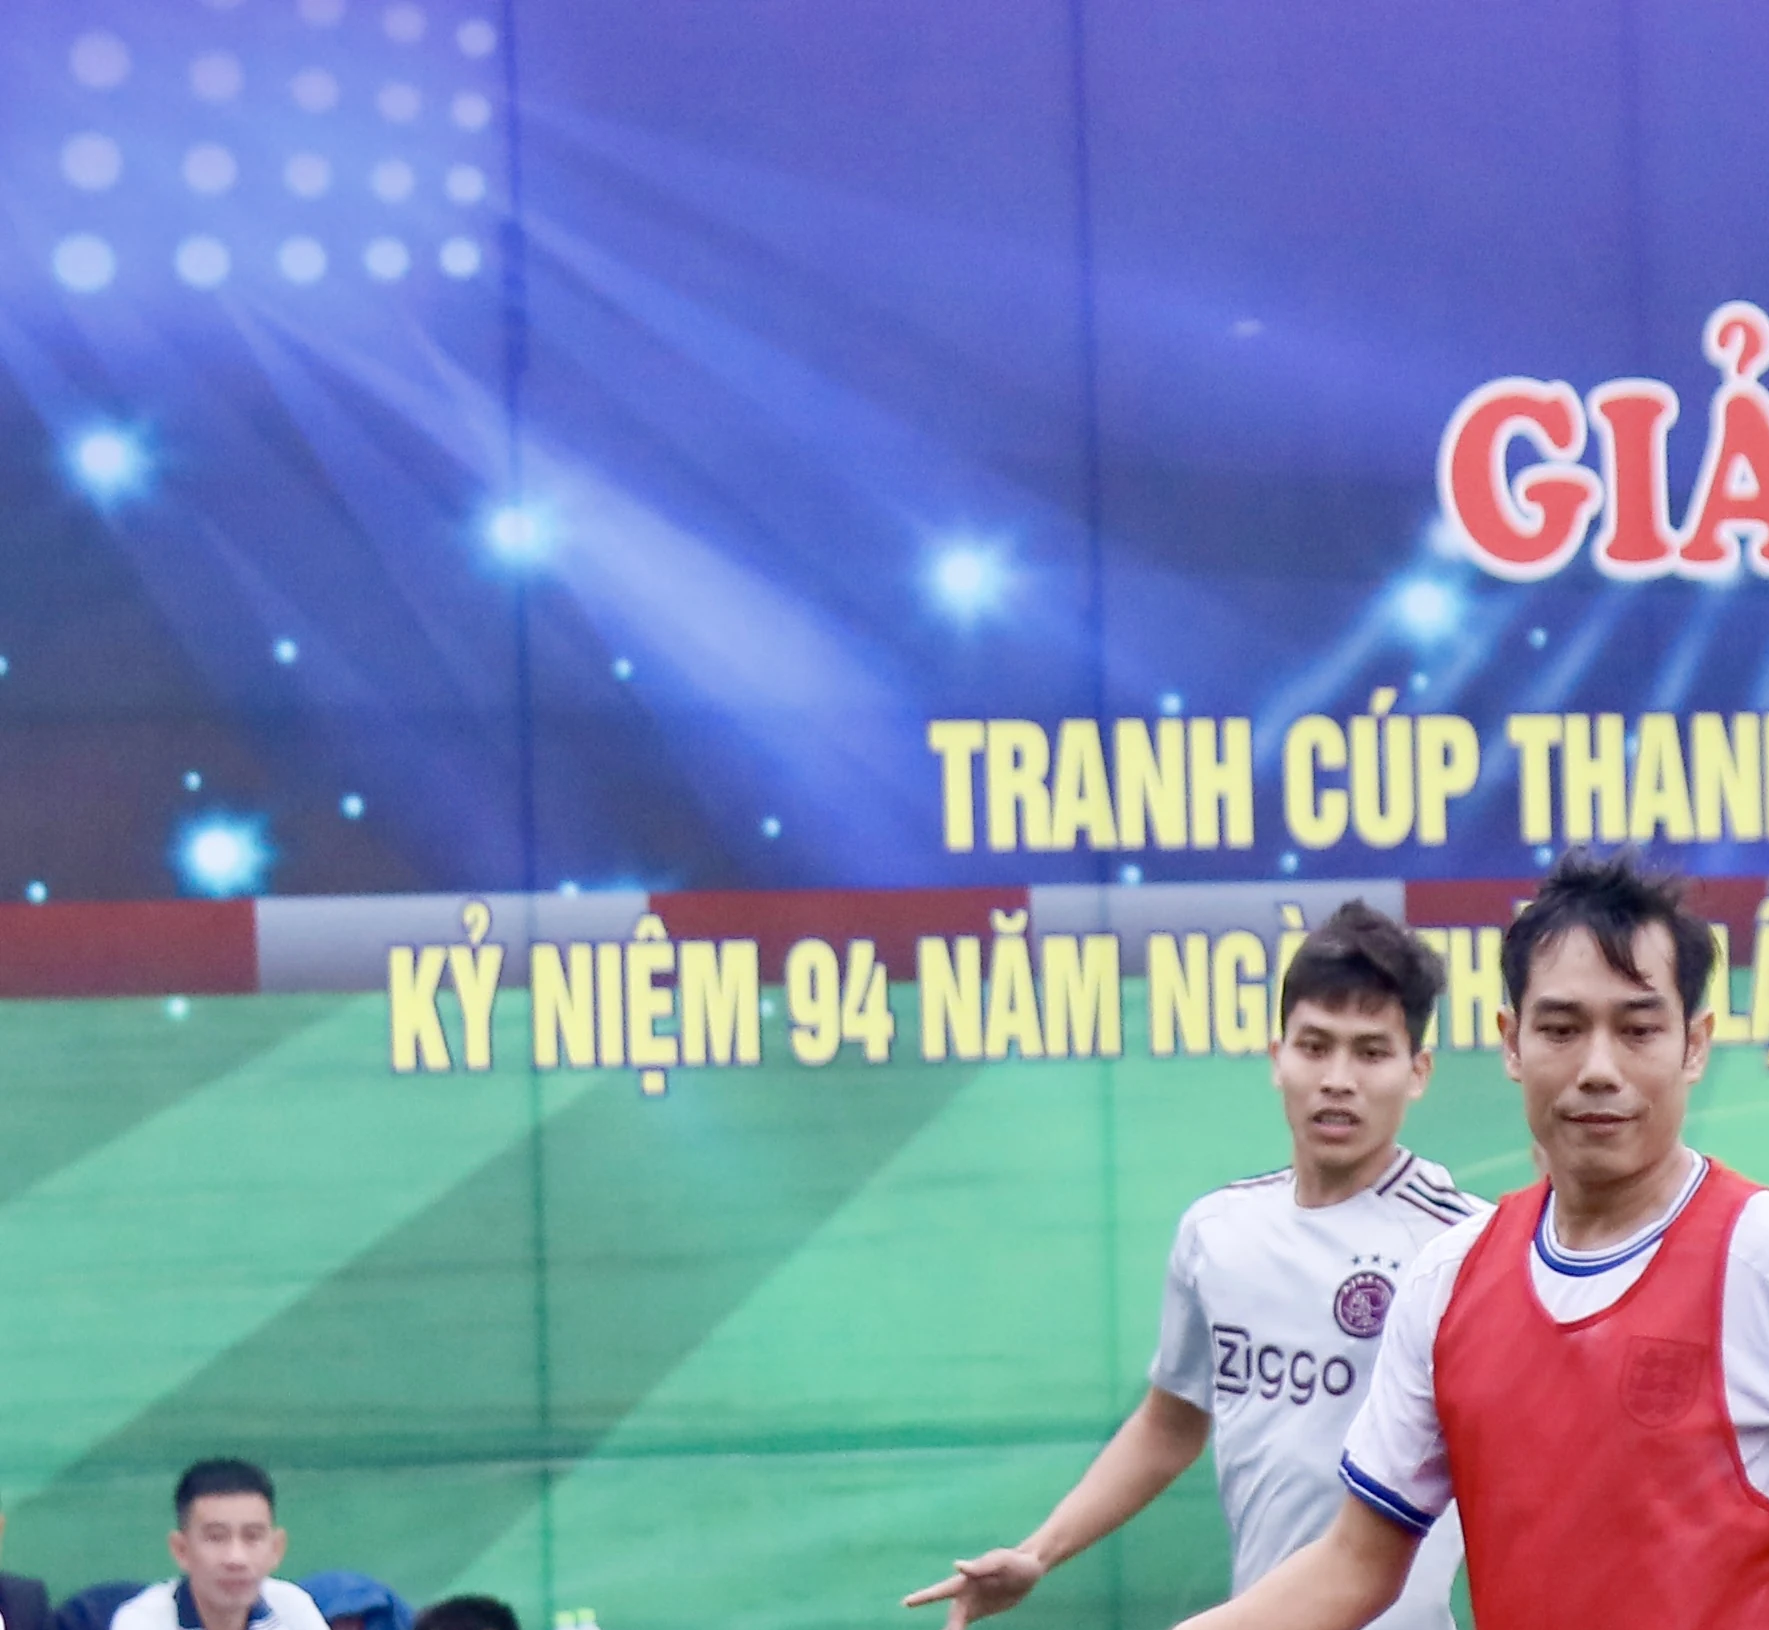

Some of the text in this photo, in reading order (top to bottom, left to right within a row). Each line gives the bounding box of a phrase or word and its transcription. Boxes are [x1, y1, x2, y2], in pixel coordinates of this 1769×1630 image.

[928, 716, 1255, 852] TRANH
[1282, 686, 1482, 850] CÚP
[388, 900, 504, 1073] KỶ
[530, 914, 762, 1097] NIỆM
[785, 937, 894, 1065] 94
[917, 908, 1123, 1062] NĂM
